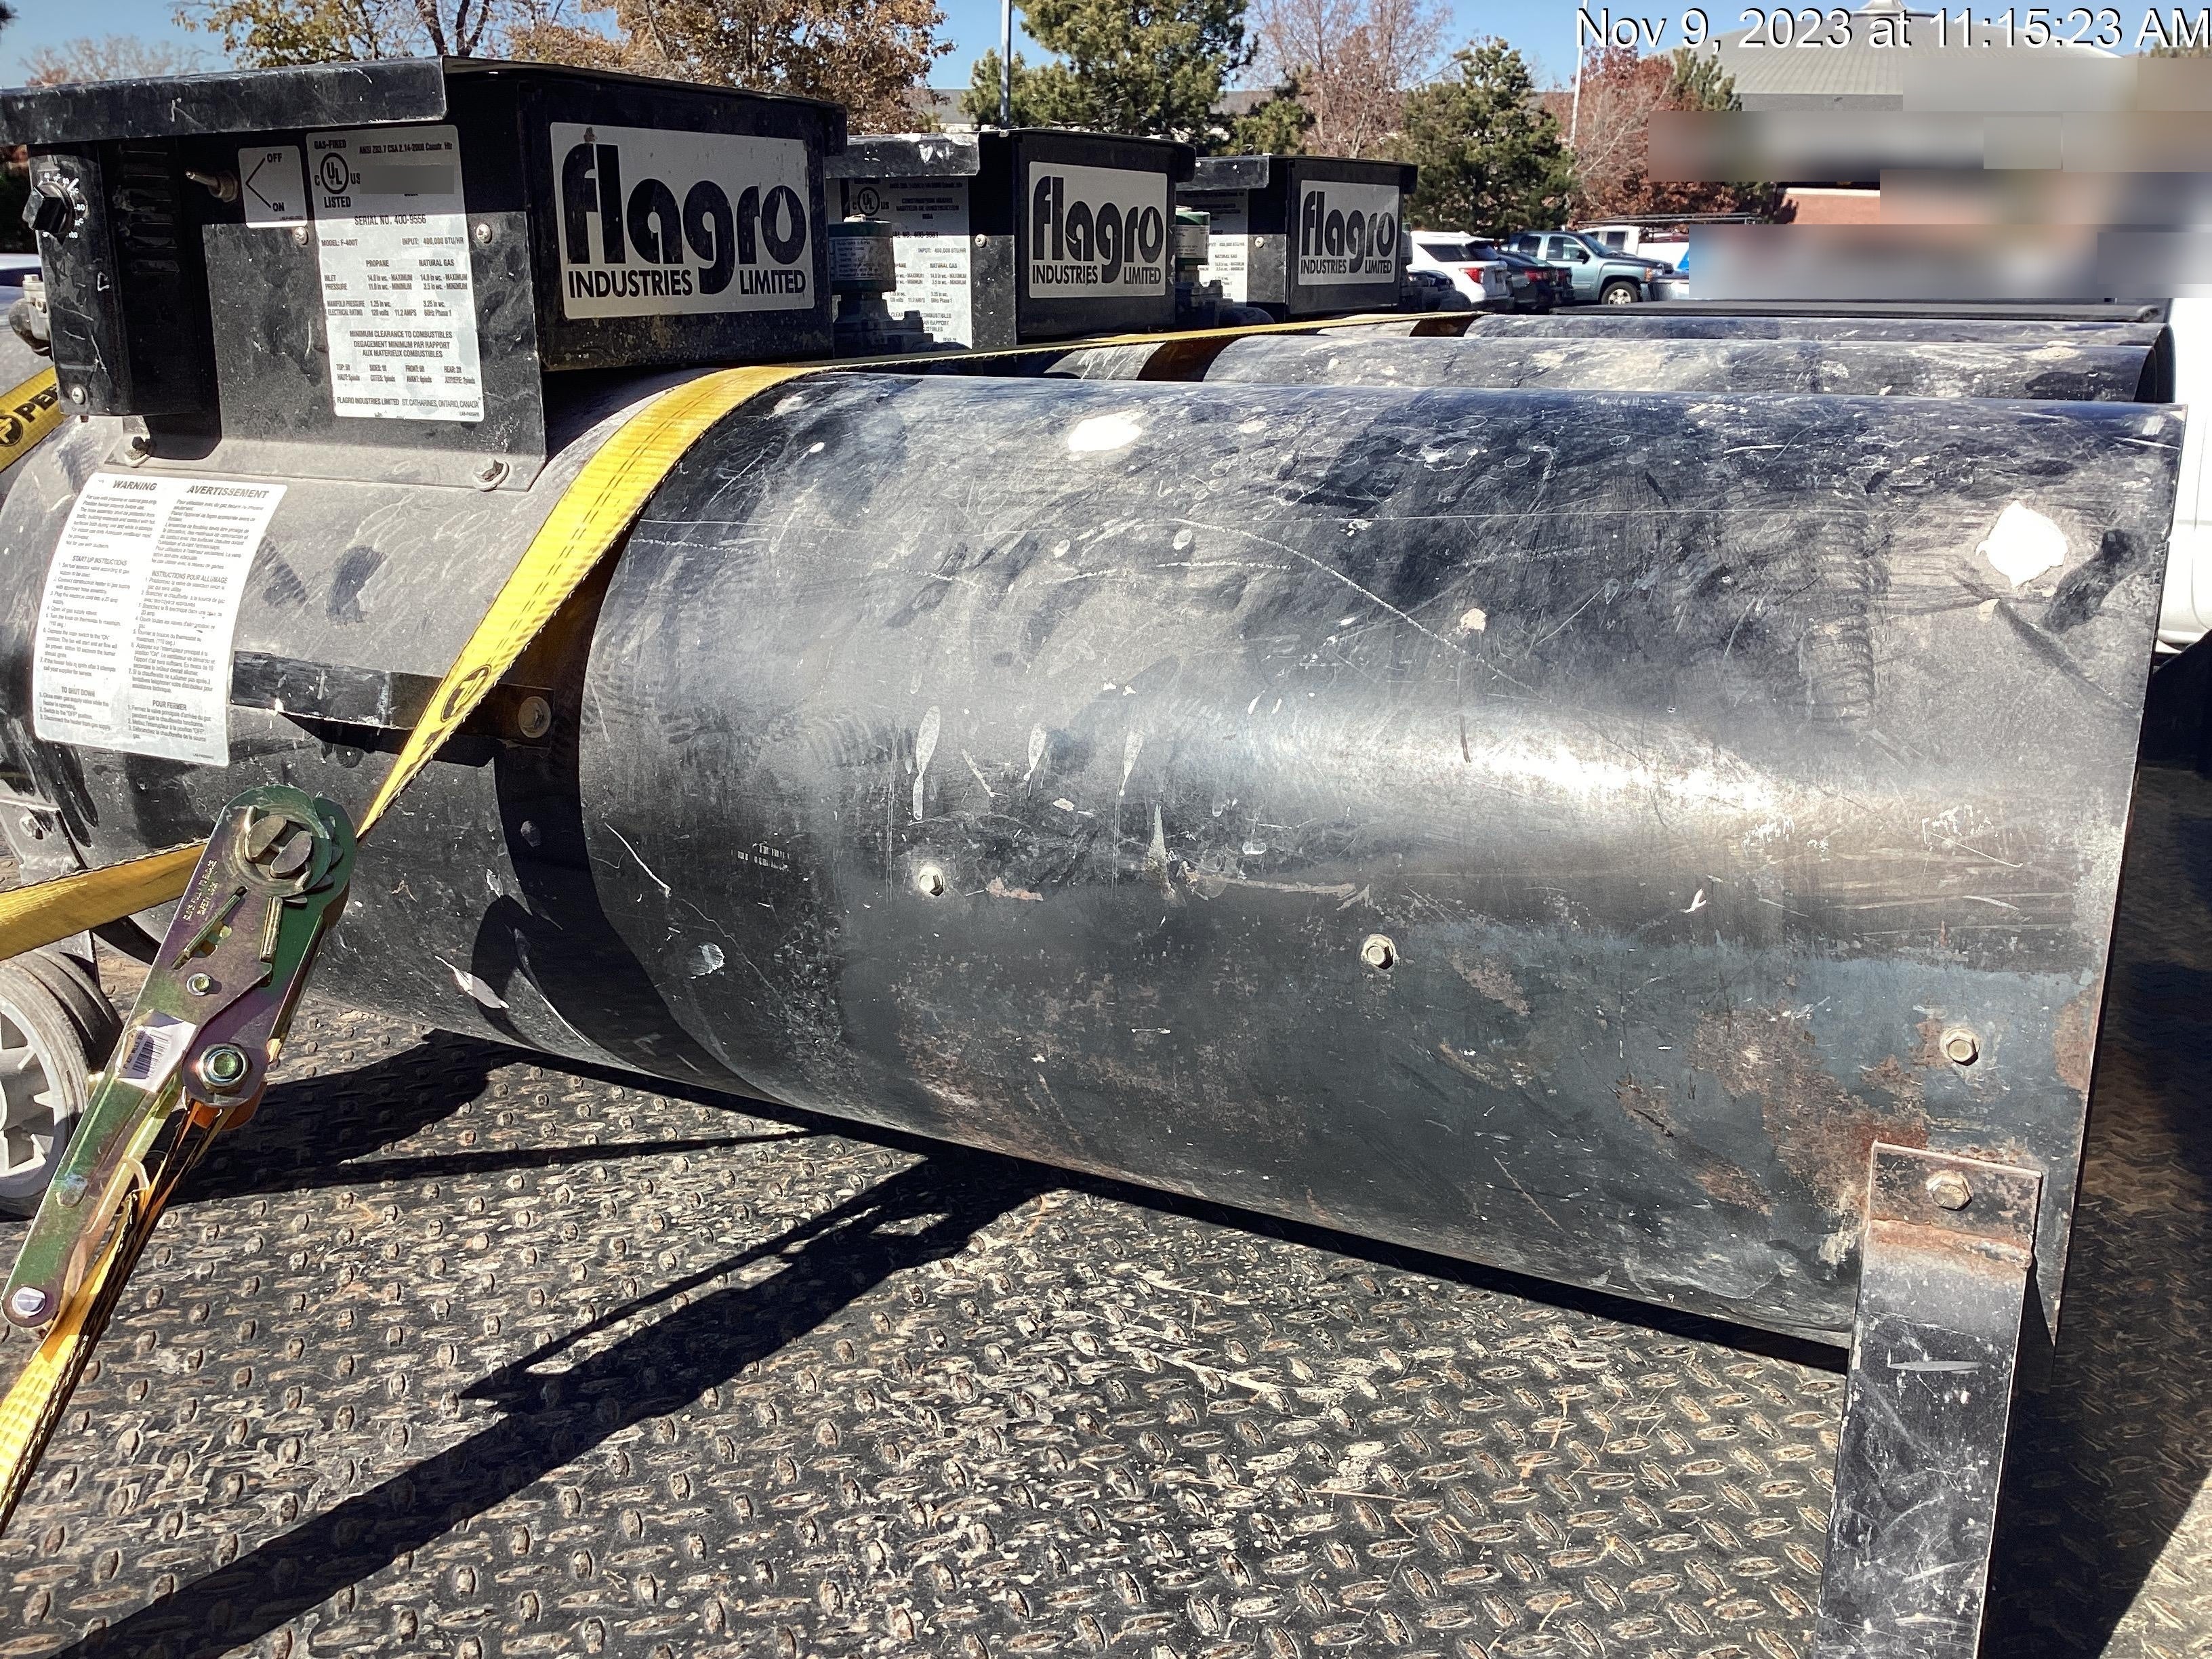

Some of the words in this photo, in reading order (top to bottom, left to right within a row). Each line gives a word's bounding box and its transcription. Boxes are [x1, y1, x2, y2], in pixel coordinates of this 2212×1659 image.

[388, 144, 398, 152] CSA
[267, 153, 282, 163] OFF
[314, 175, 320, 186] C
[350, 173, 360, 184] US
[272, 202, 285, 211] ON
[324, 197, 351, 207] LISTED
[354, 215, 378, 225] SERIAL
[380, 216, 392, 225] NO.
[562, 143, 806, 295] flagro
[1033, 176, 1164, 283] flagro
[1301, 190, 1395, 272] flagro
[1301, 259, 1347, 274] INDUSTRIES
[1365, 260, 1393, 274] LIMITED
[1033, 265, 1098, 284] INDUSTRIES
[1124, 267, 1161, 285] LIMITED
[569, 269, 693, 298] INDUSTRIES
[739, 270, 806, 295] LIMITED
[113, 480, 157, 490] WARNING
[187, 485, 269, 498] AVERTISSEMENT
